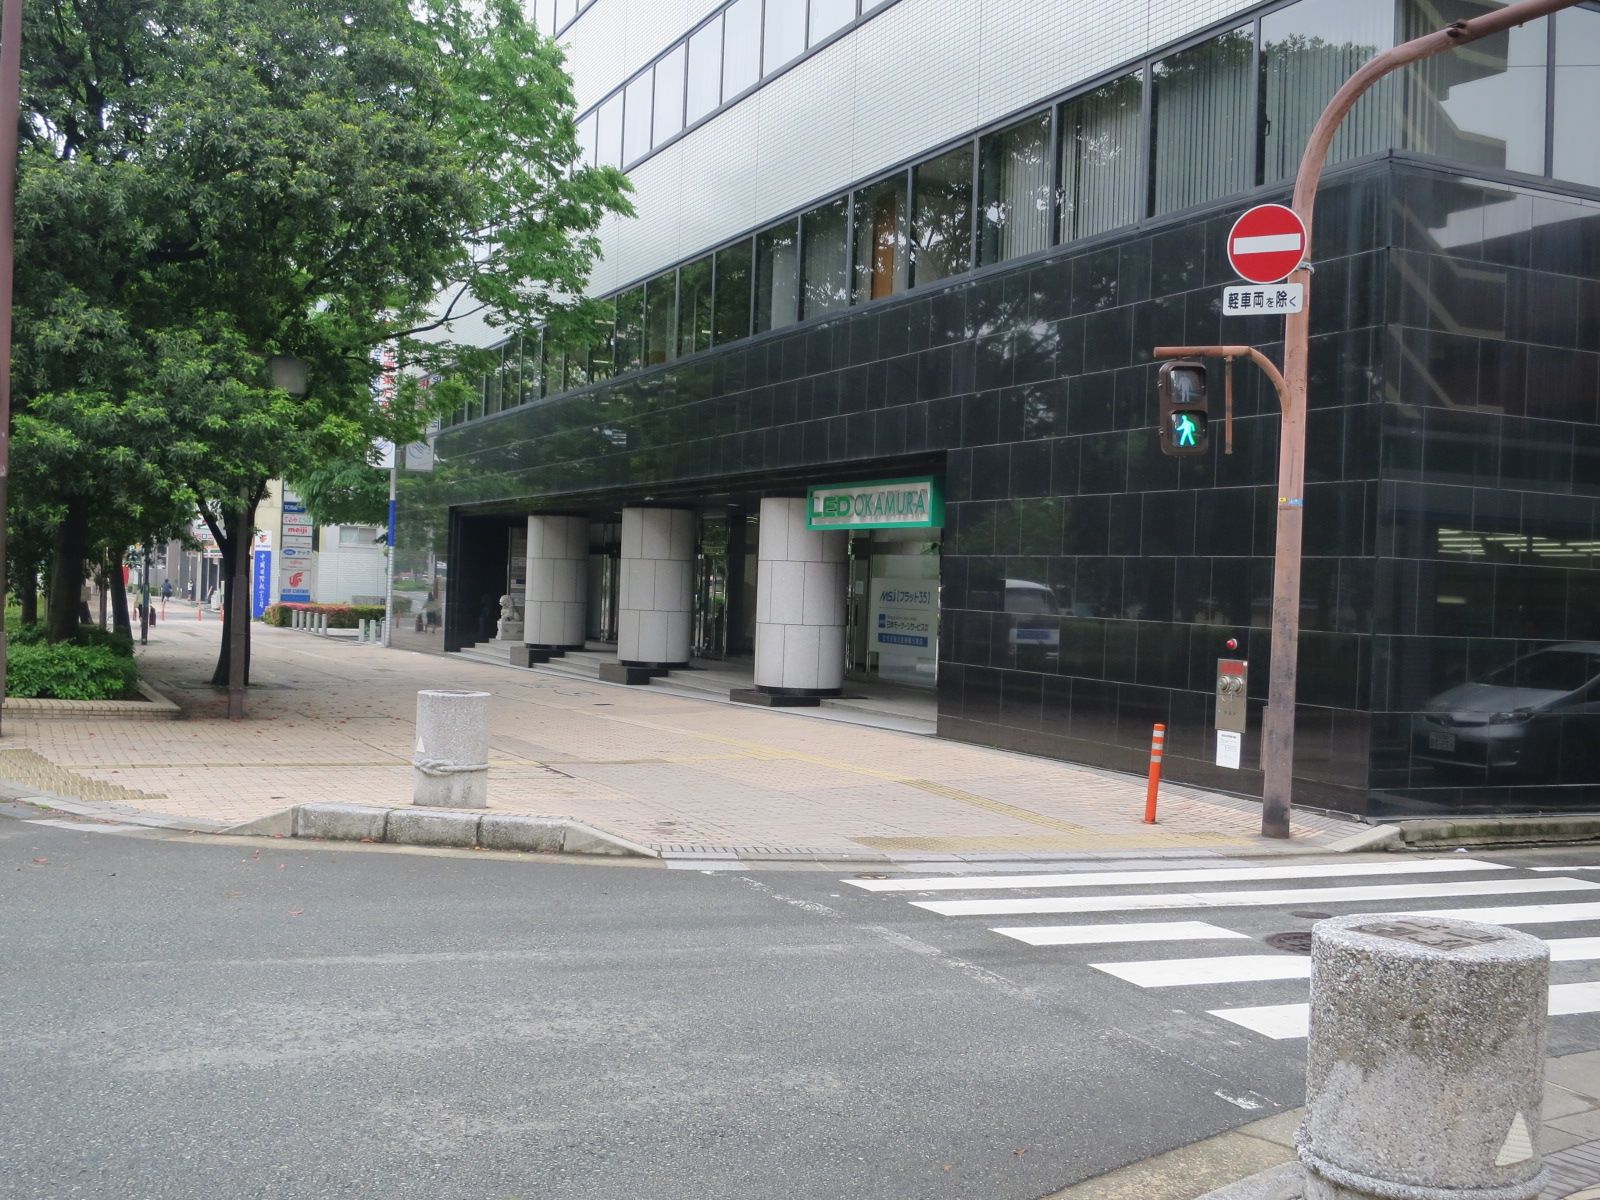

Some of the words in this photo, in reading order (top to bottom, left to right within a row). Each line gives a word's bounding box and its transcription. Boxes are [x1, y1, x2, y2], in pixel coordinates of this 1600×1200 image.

[1228, 290, 1297, 310] 軽車両を除く
[811, 496, 851, 518] LED
[854, 488, 926, 517] OKAMURA
[287, 526, 308, 535] meiji
